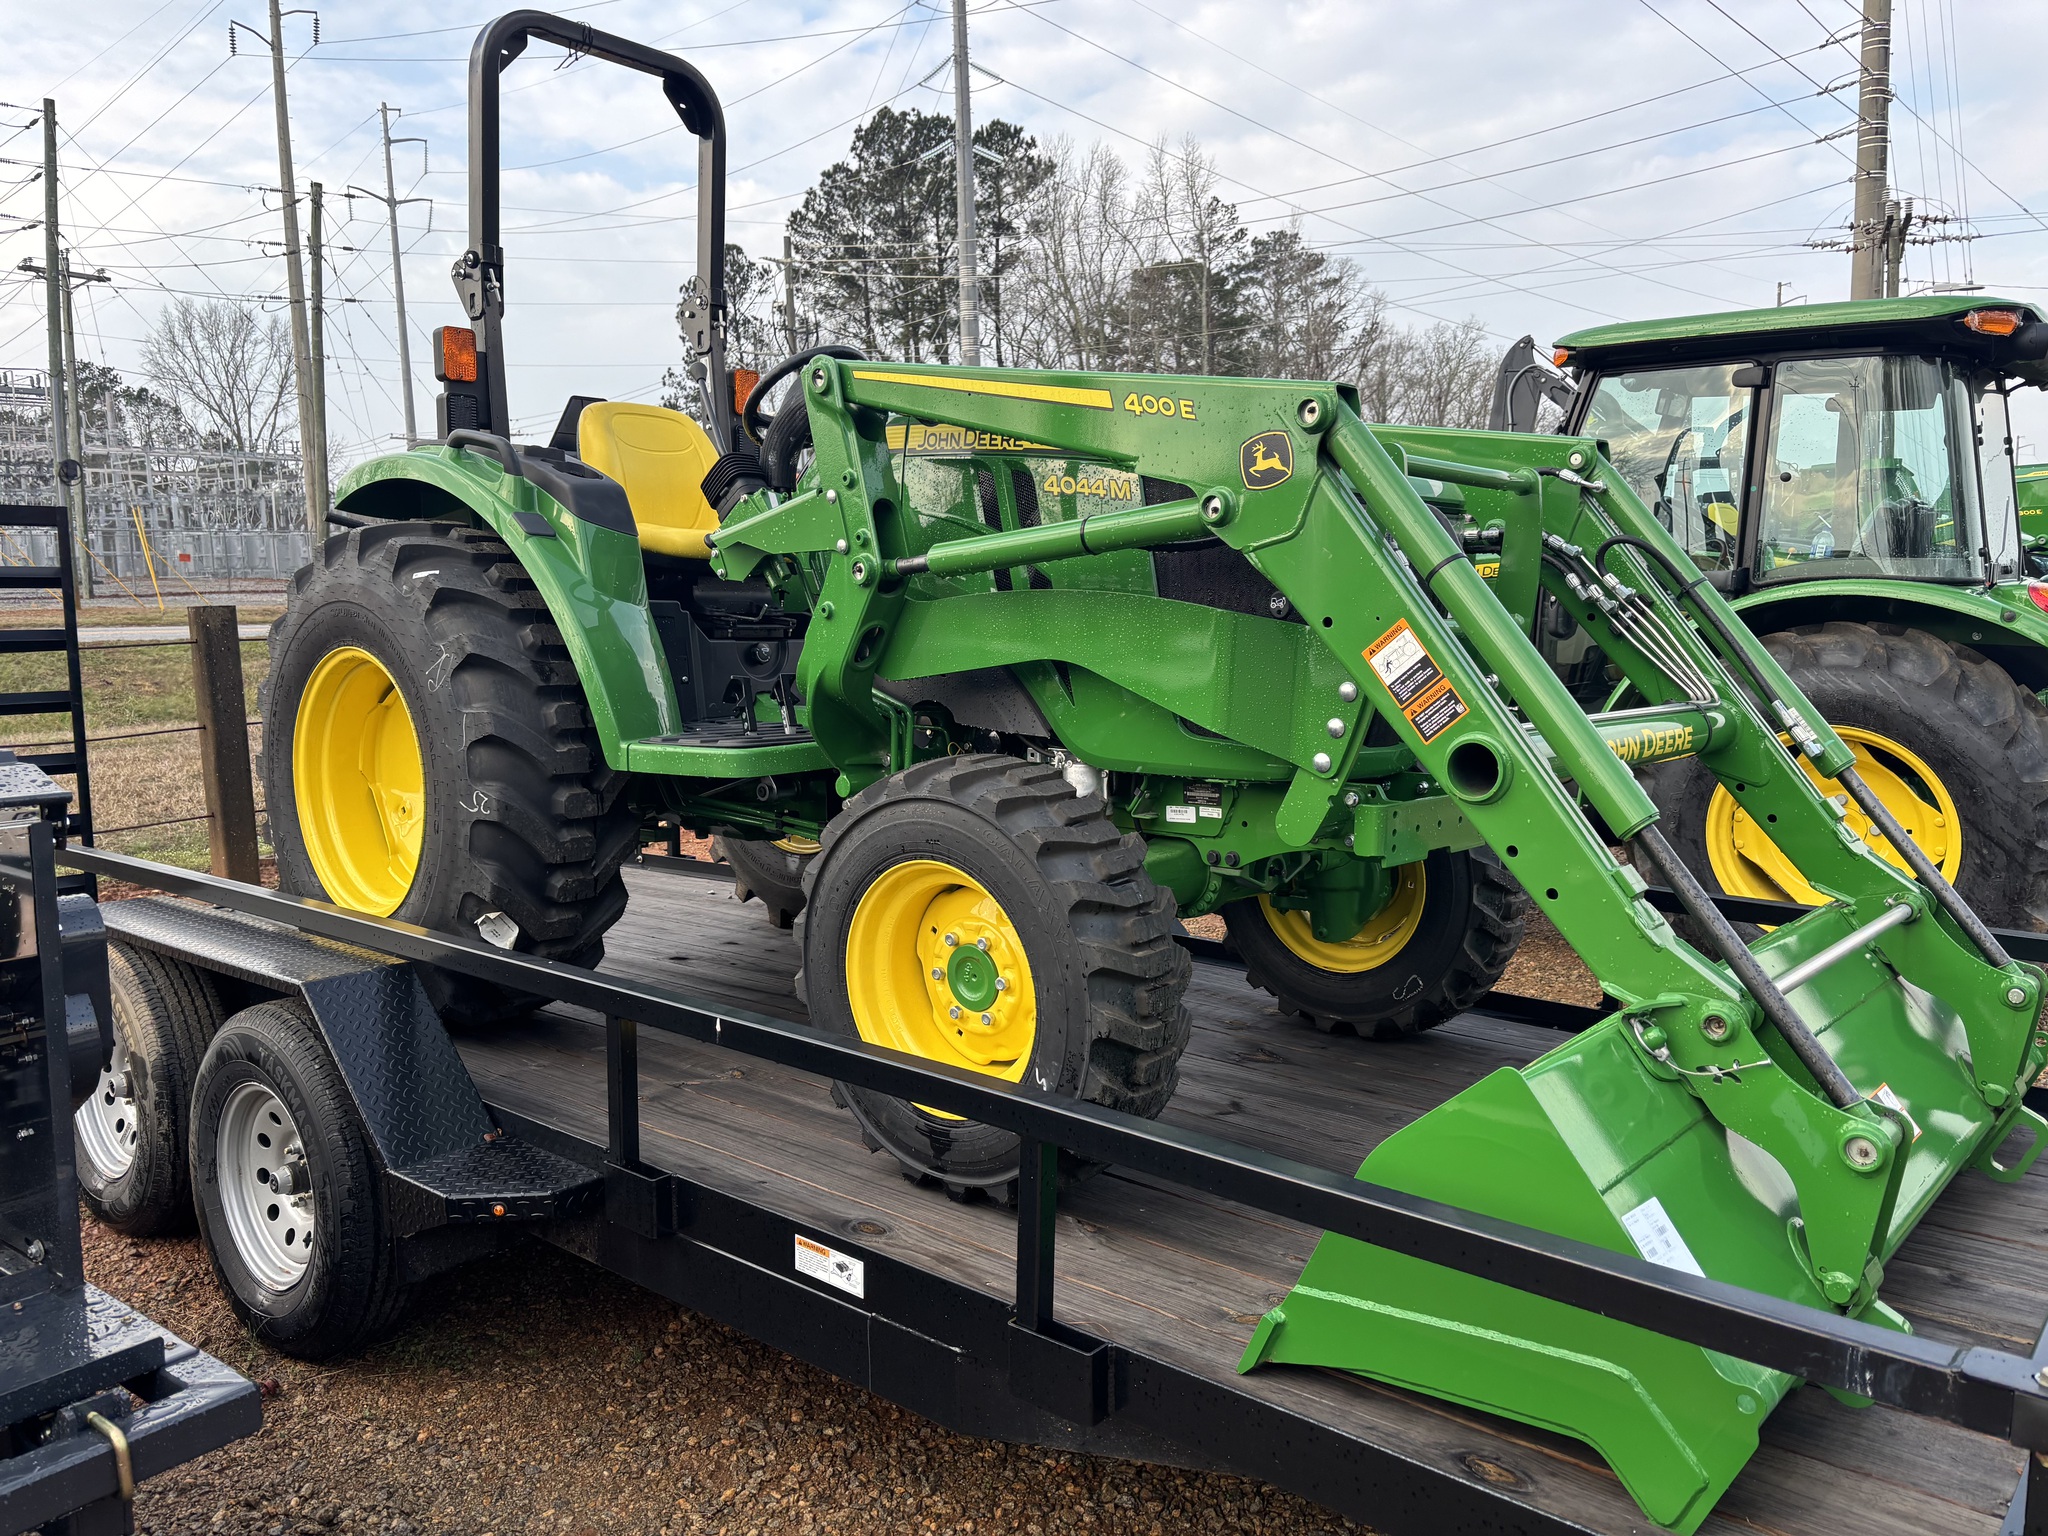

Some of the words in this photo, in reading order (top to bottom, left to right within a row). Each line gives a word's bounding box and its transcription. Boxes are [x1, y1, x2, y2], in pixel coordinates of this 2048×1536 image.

[918, 429, 961, 448] JOHN
[1374, 624, 1403, 650] WARNING
[1416, 684, 1447, 709] WARNING
[1641, 725, 1693, 758] DEERE
[803, 1240, 826, 1255] WARNING
